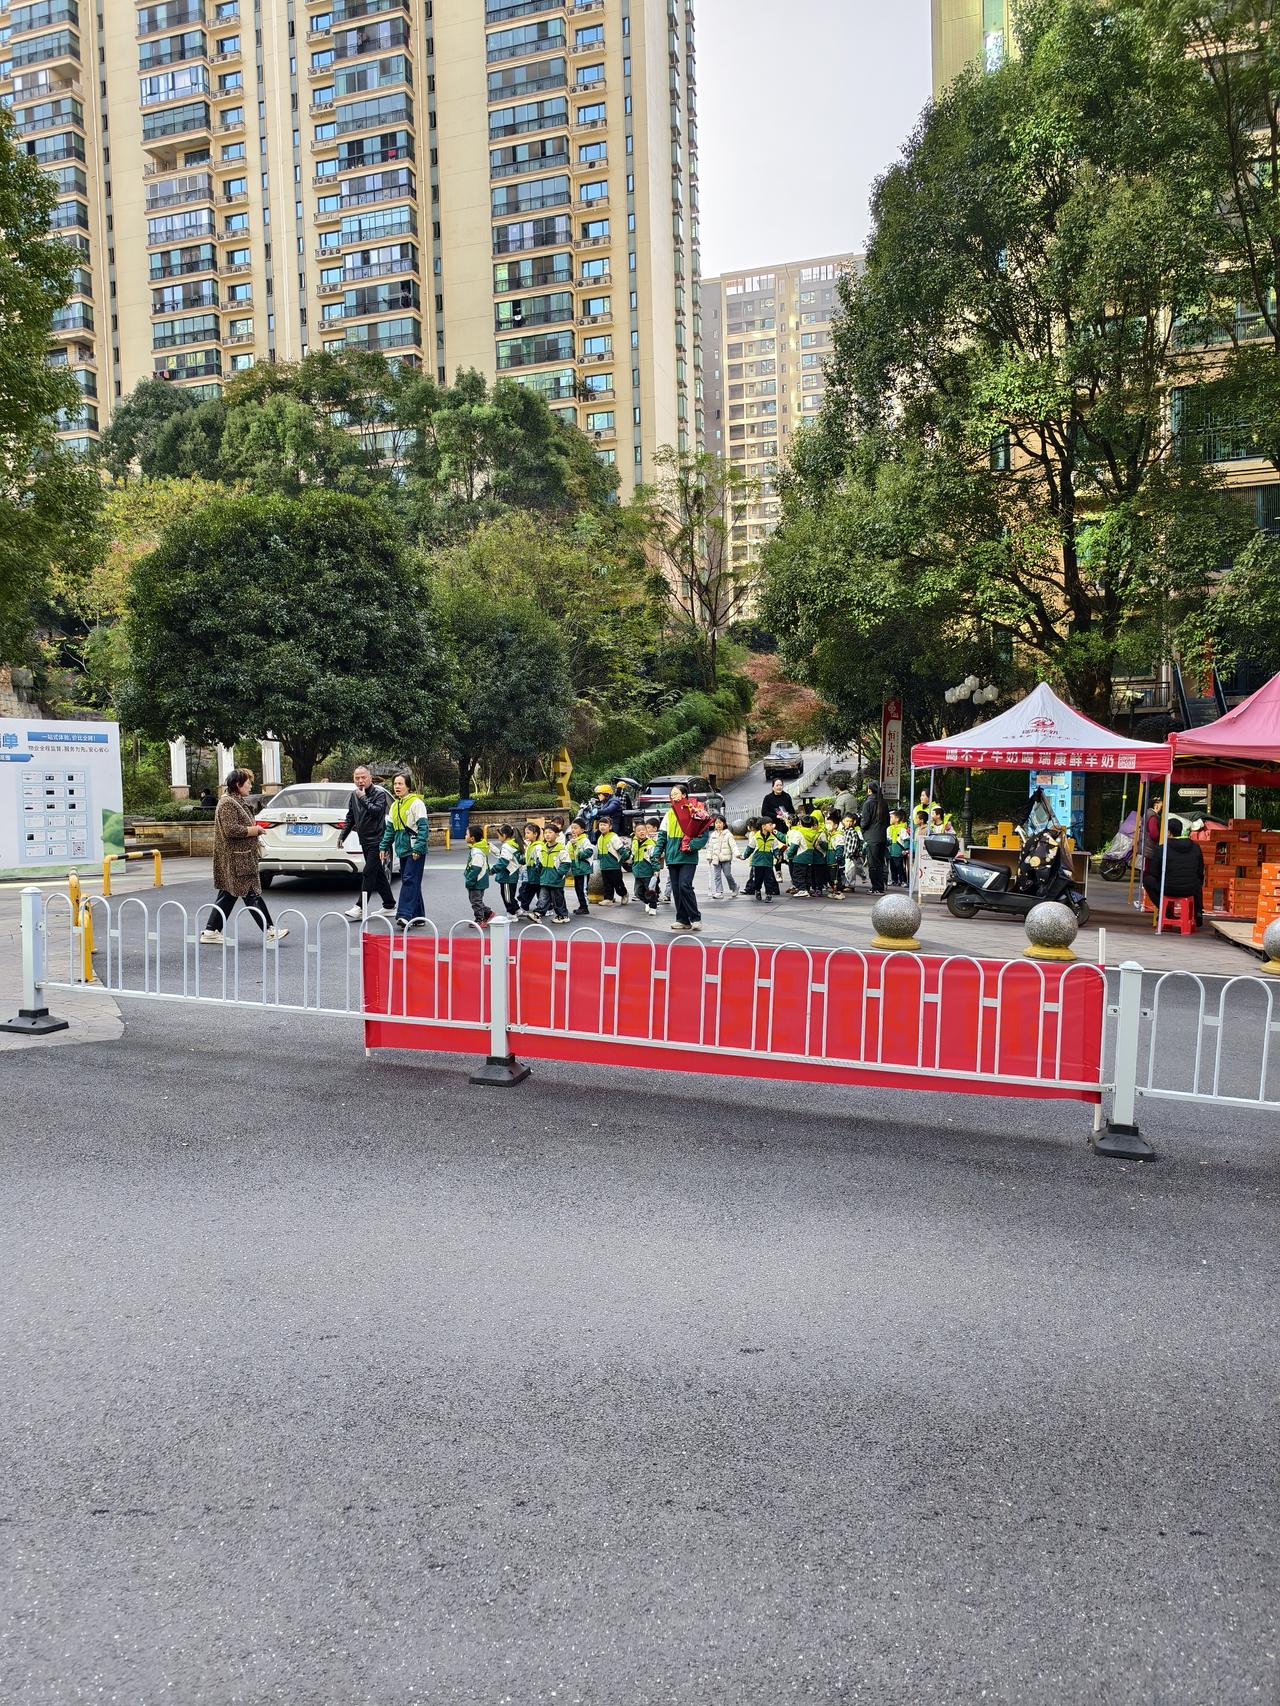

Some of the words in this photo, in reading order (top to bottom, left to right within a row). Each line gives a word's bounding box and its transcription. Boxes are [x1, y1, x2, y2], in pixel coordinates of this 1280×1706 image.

[945, 749, 1114, 768] 喝不了牛奶喝瑞康鲜羊奶
